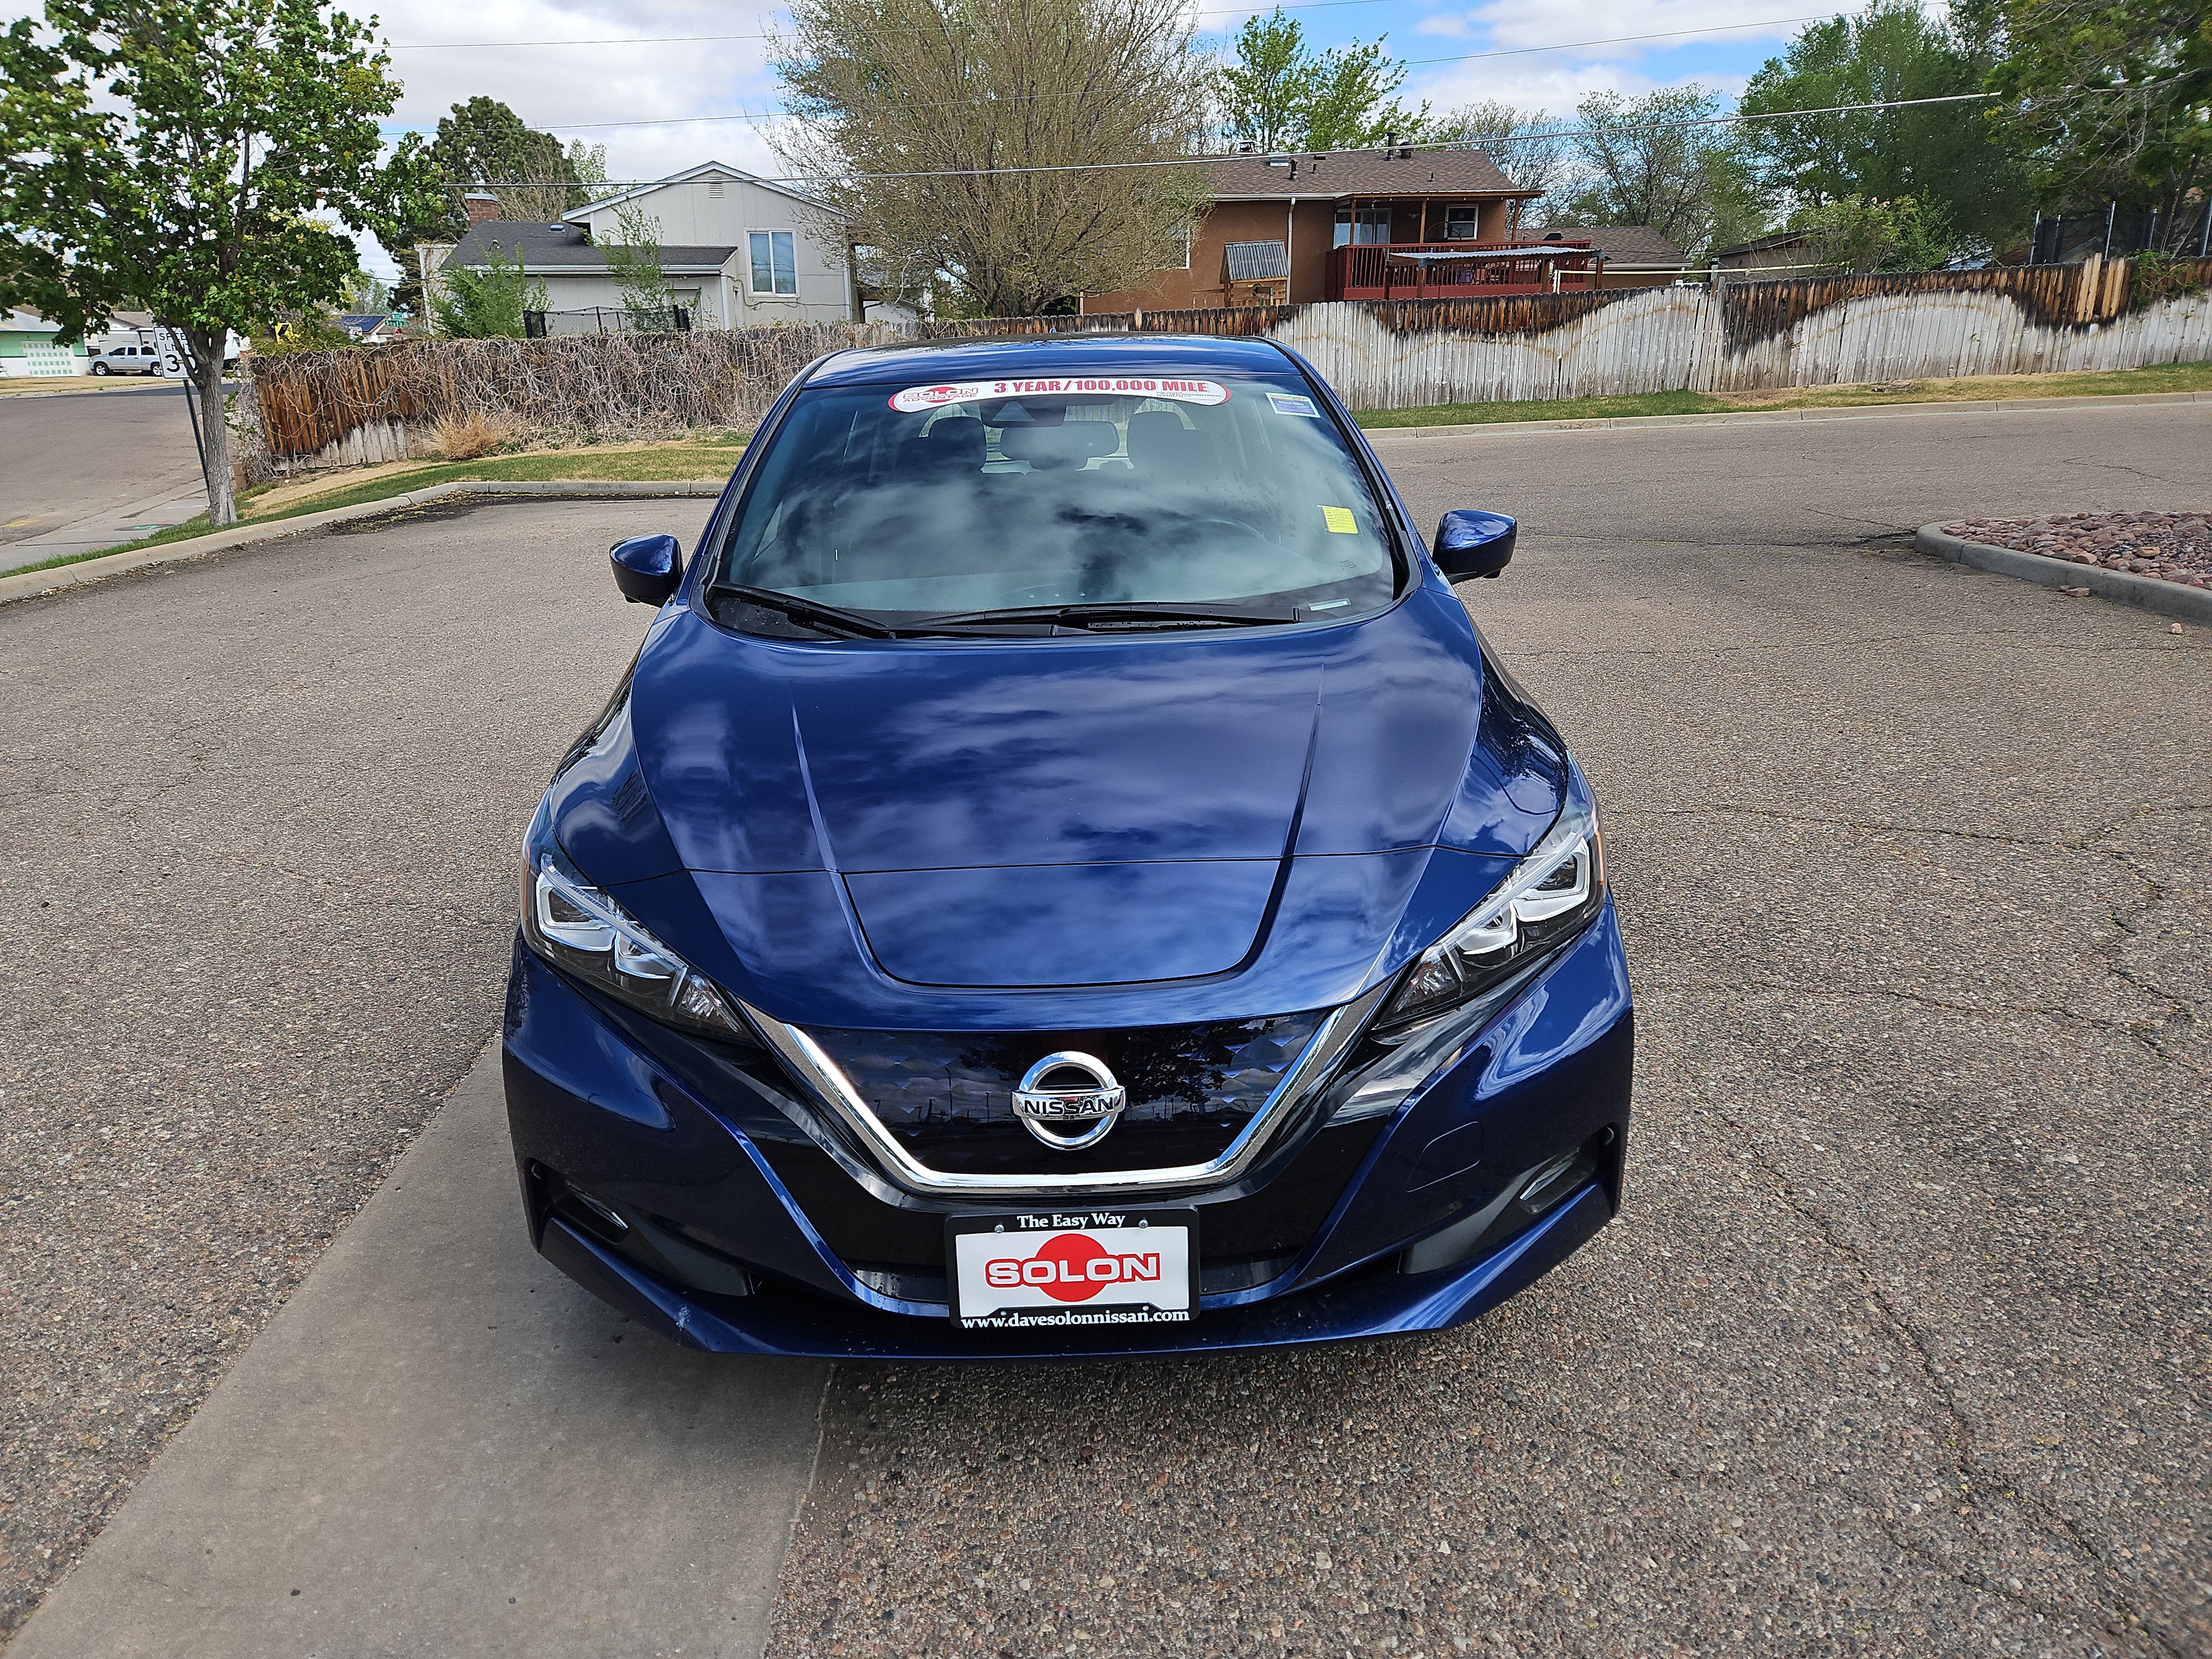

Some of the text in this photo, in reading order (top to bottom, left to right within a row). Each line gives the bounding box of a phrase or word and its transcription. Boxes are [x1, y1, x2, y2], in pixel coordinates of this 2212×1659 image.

[903, 388, 979, 399] SOLON
[994, 380, 1208, 393] 3 YEAR/100,000 MILE
[902, 394, 977, 403] ADVANTAGE
[1024, 1096, 1114, 1116] NISSAN
[1017, 1212, 1126, 1230] The Easy Way
[986, 1253, 1160, 1287] SOLON
[961, 1309, 1190, 1329] www.davesolonnissan.com
